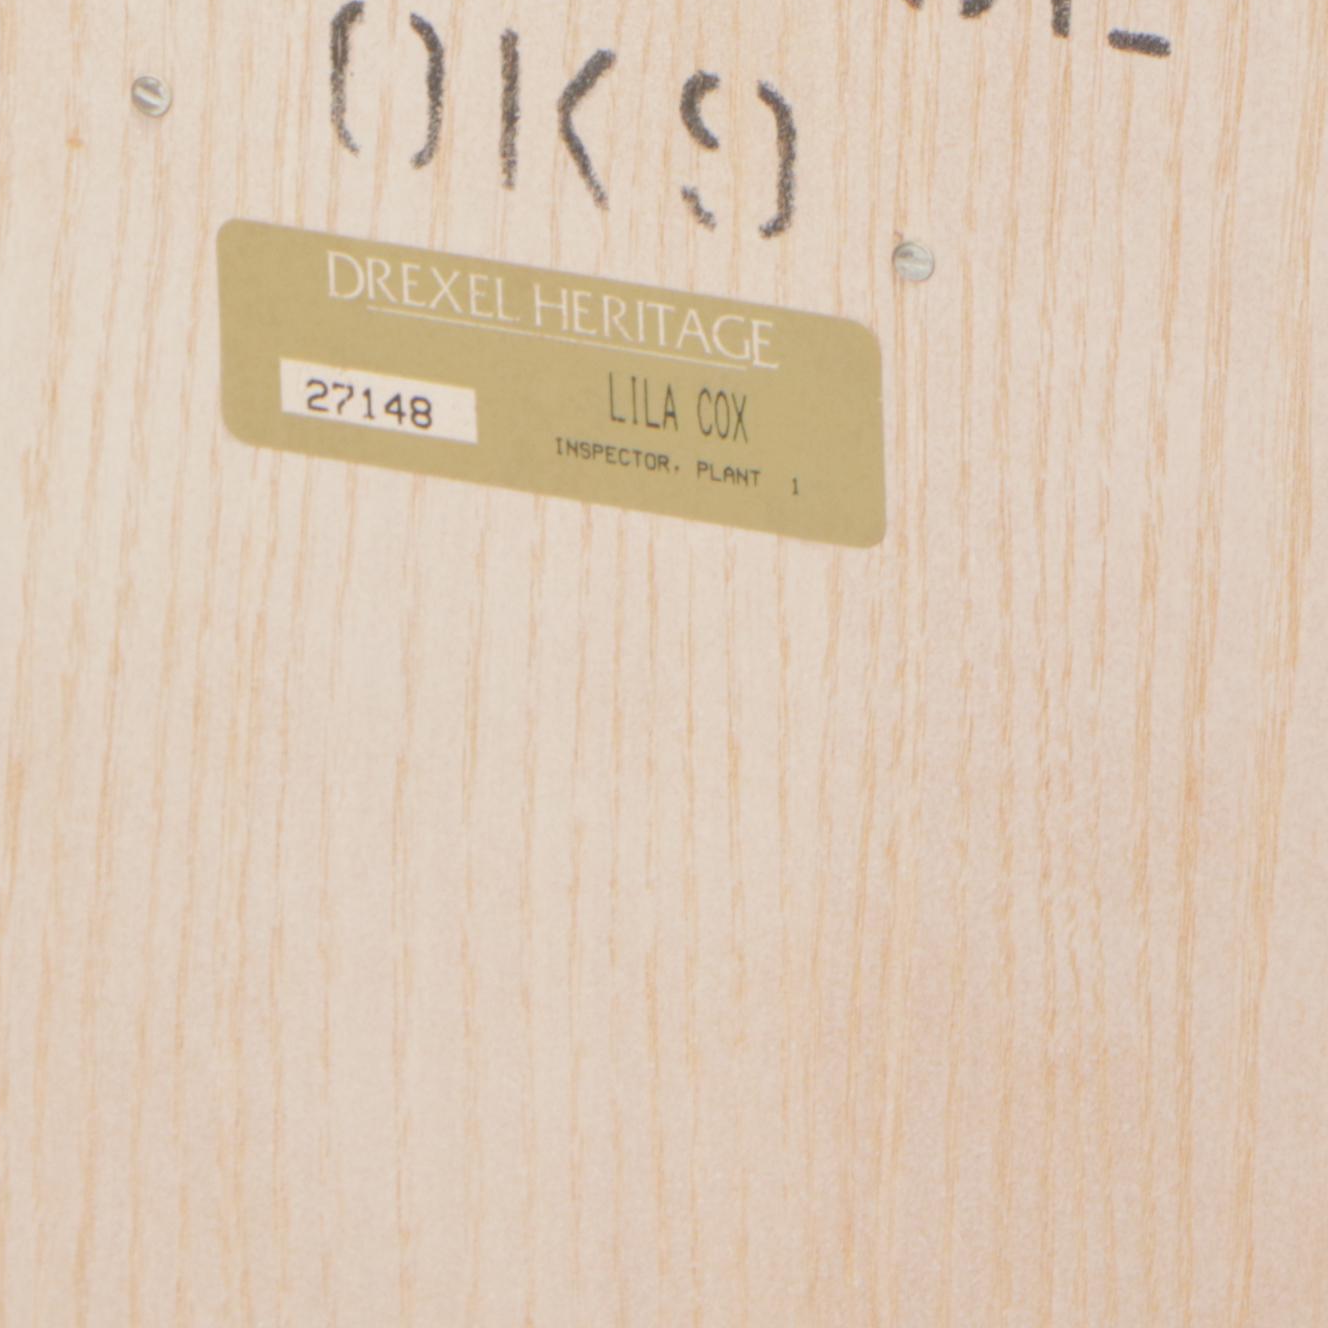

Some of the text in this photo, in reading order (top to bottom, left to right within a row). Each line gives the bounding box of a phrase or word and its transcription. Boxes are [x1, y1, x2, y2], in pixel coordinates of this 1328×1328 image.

[326, 249, 780, 370] DREXEL HERITAGE
[305, 377, 434, 430] 27148
[608, 371, 749, 444] LILA COX
[696, 460, 761, 488] PLANT
